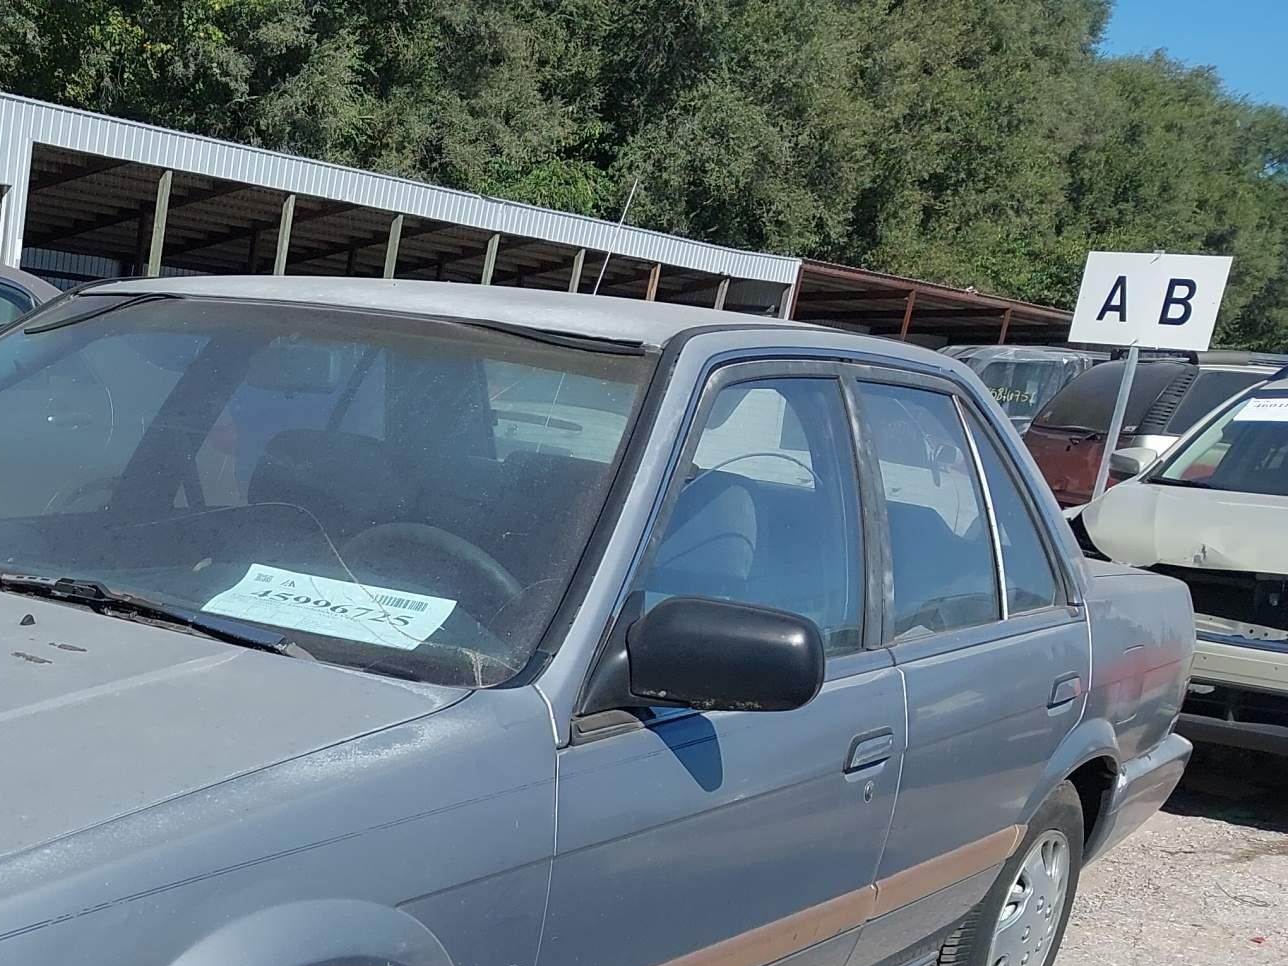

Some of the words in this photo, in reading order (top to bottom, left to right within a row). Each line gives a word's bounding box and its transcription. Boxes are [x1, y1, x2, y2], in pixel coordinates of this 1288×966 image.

[1096, 275, 1127, 322] A
[1158, 278, 1197, 326] B
[252, 590, 415, 626] 45996725
